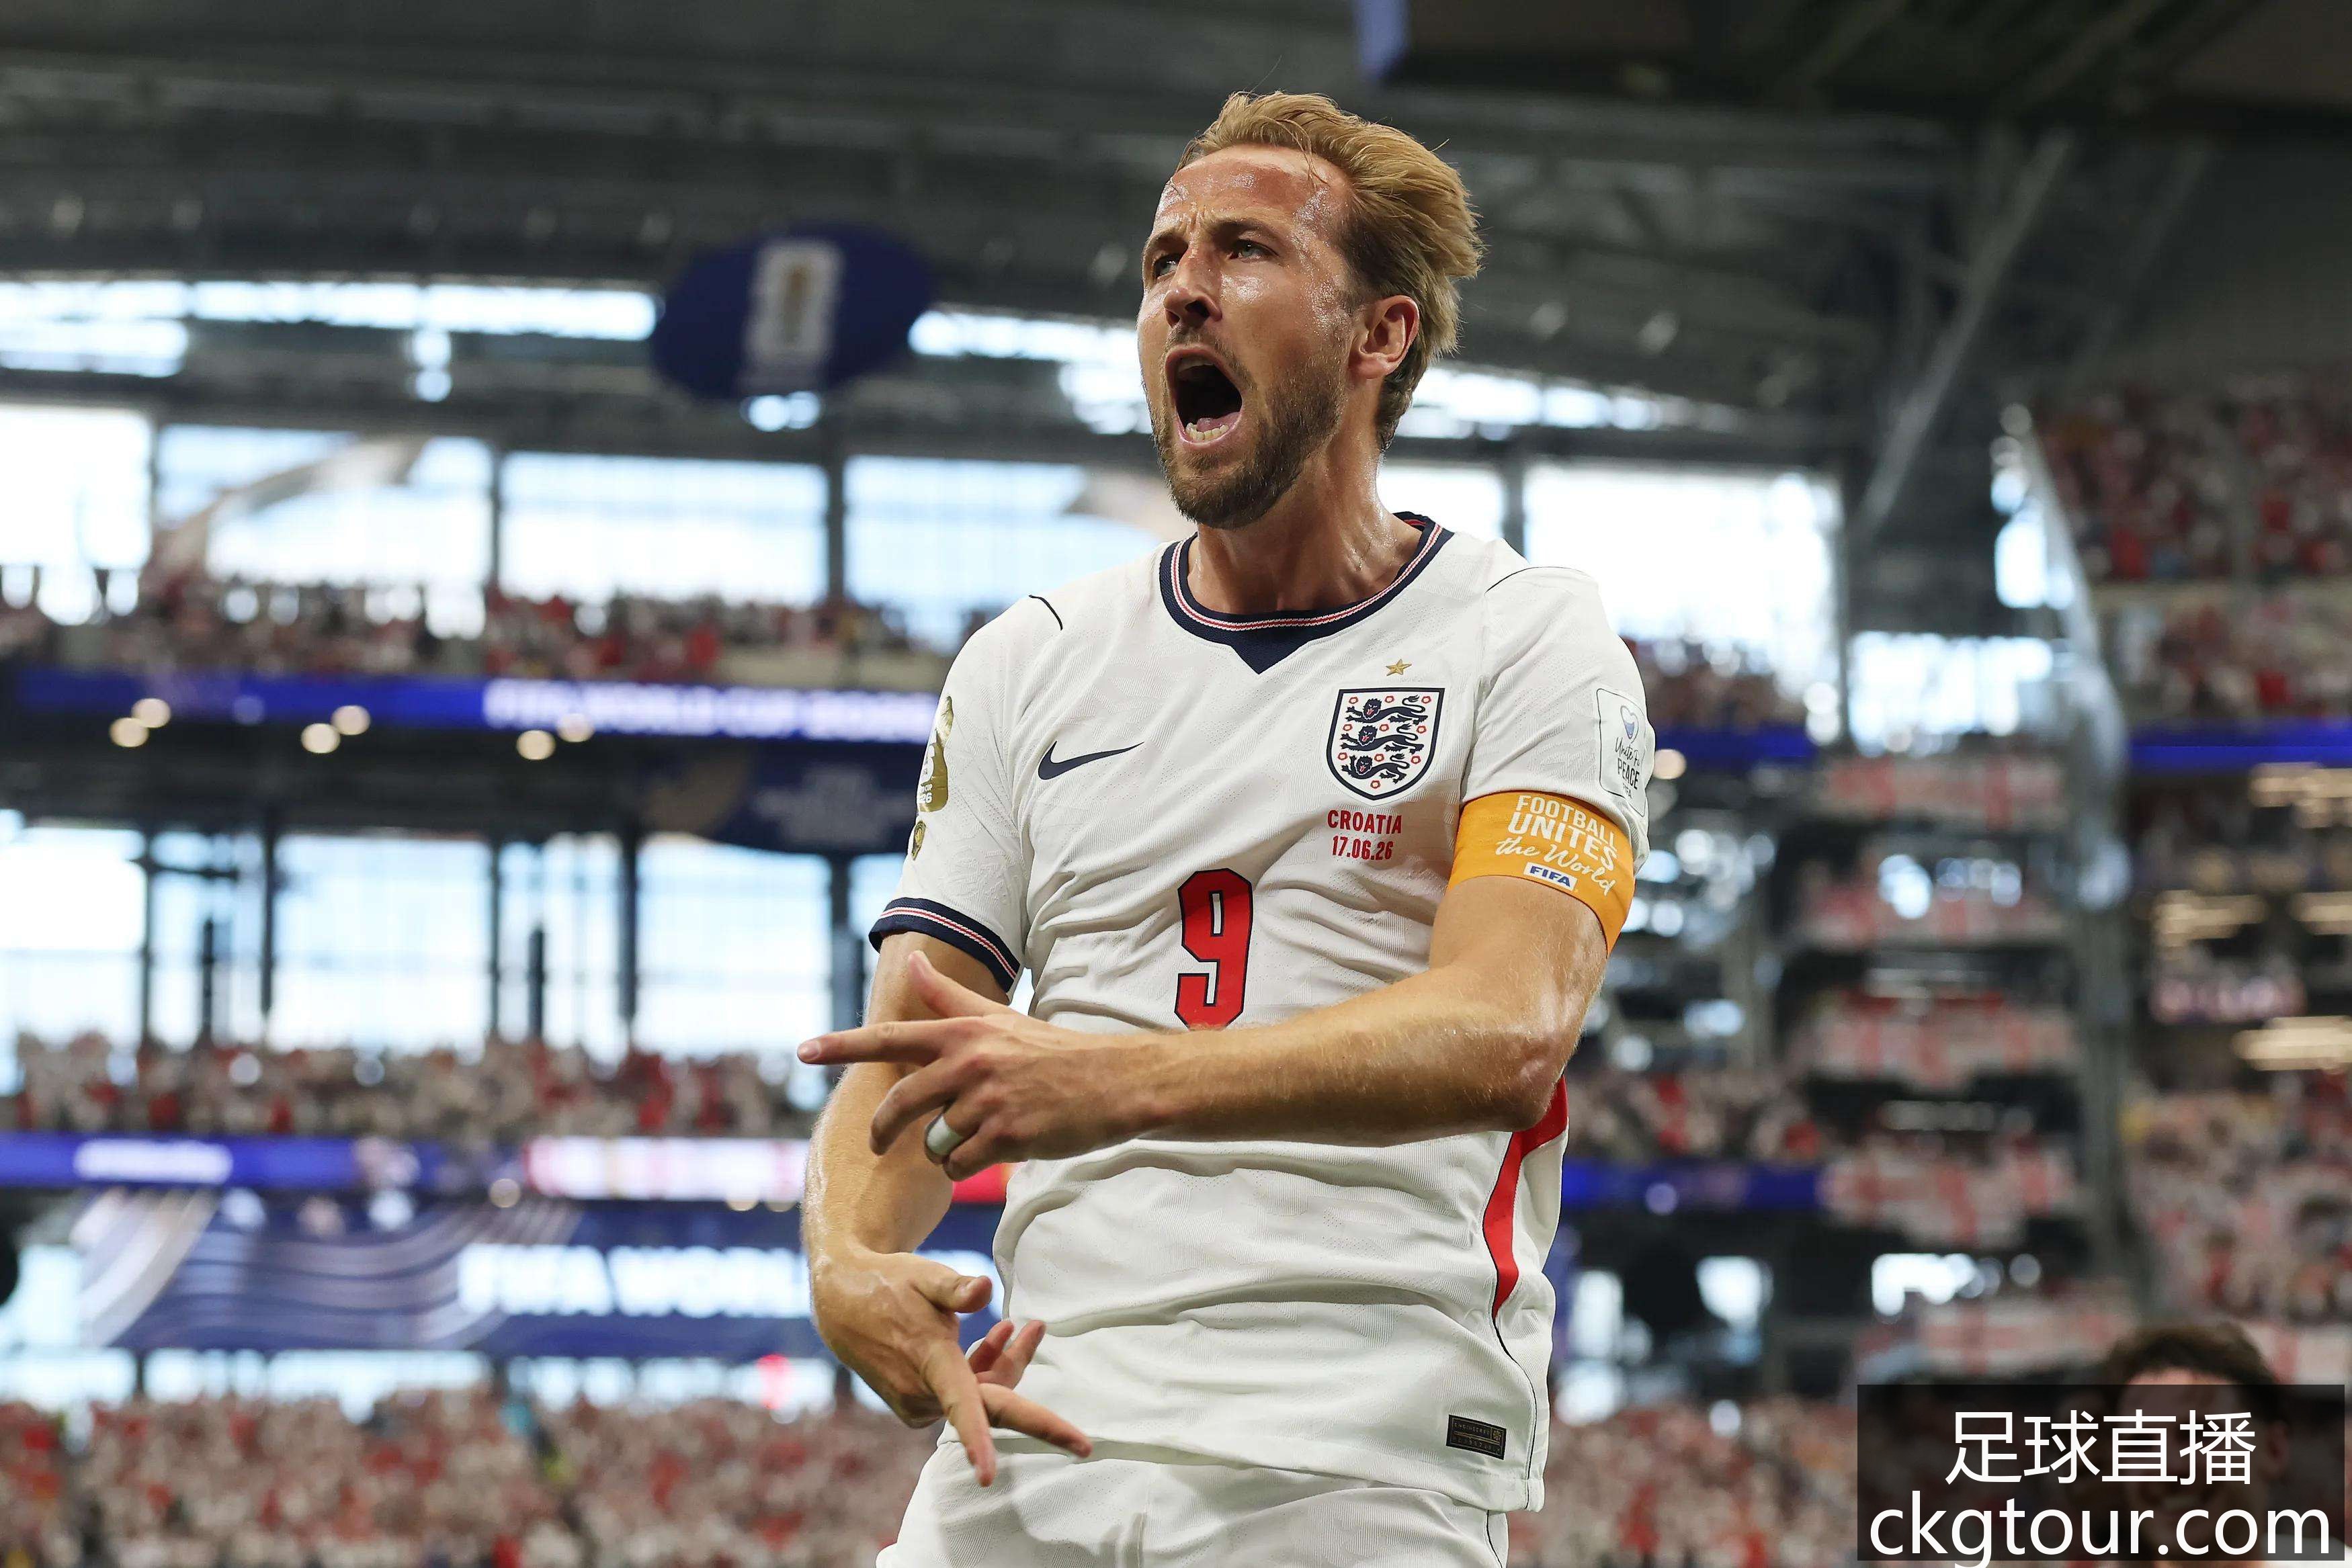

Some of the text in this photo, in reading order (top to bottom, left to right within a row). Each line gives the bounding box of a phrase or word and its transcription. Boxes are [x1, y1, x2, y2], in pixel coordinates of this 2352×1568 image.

[1615, 737, 1634, 760] Unite
[1618, 757, 1640, 790] PEACE
[1327, 810, 1402, 834] CROATIA
[1515, 795, 1618, 853] FOOTBALL
[1332, 835, 1394, 861] 17.06.26
[1507, 812, 1618, 871] UNITES
[1495, 836, 1616, 897] the World
[1529, 865, 1571, 887] FIFA
[1174, 868, 1254, 1031] 9
